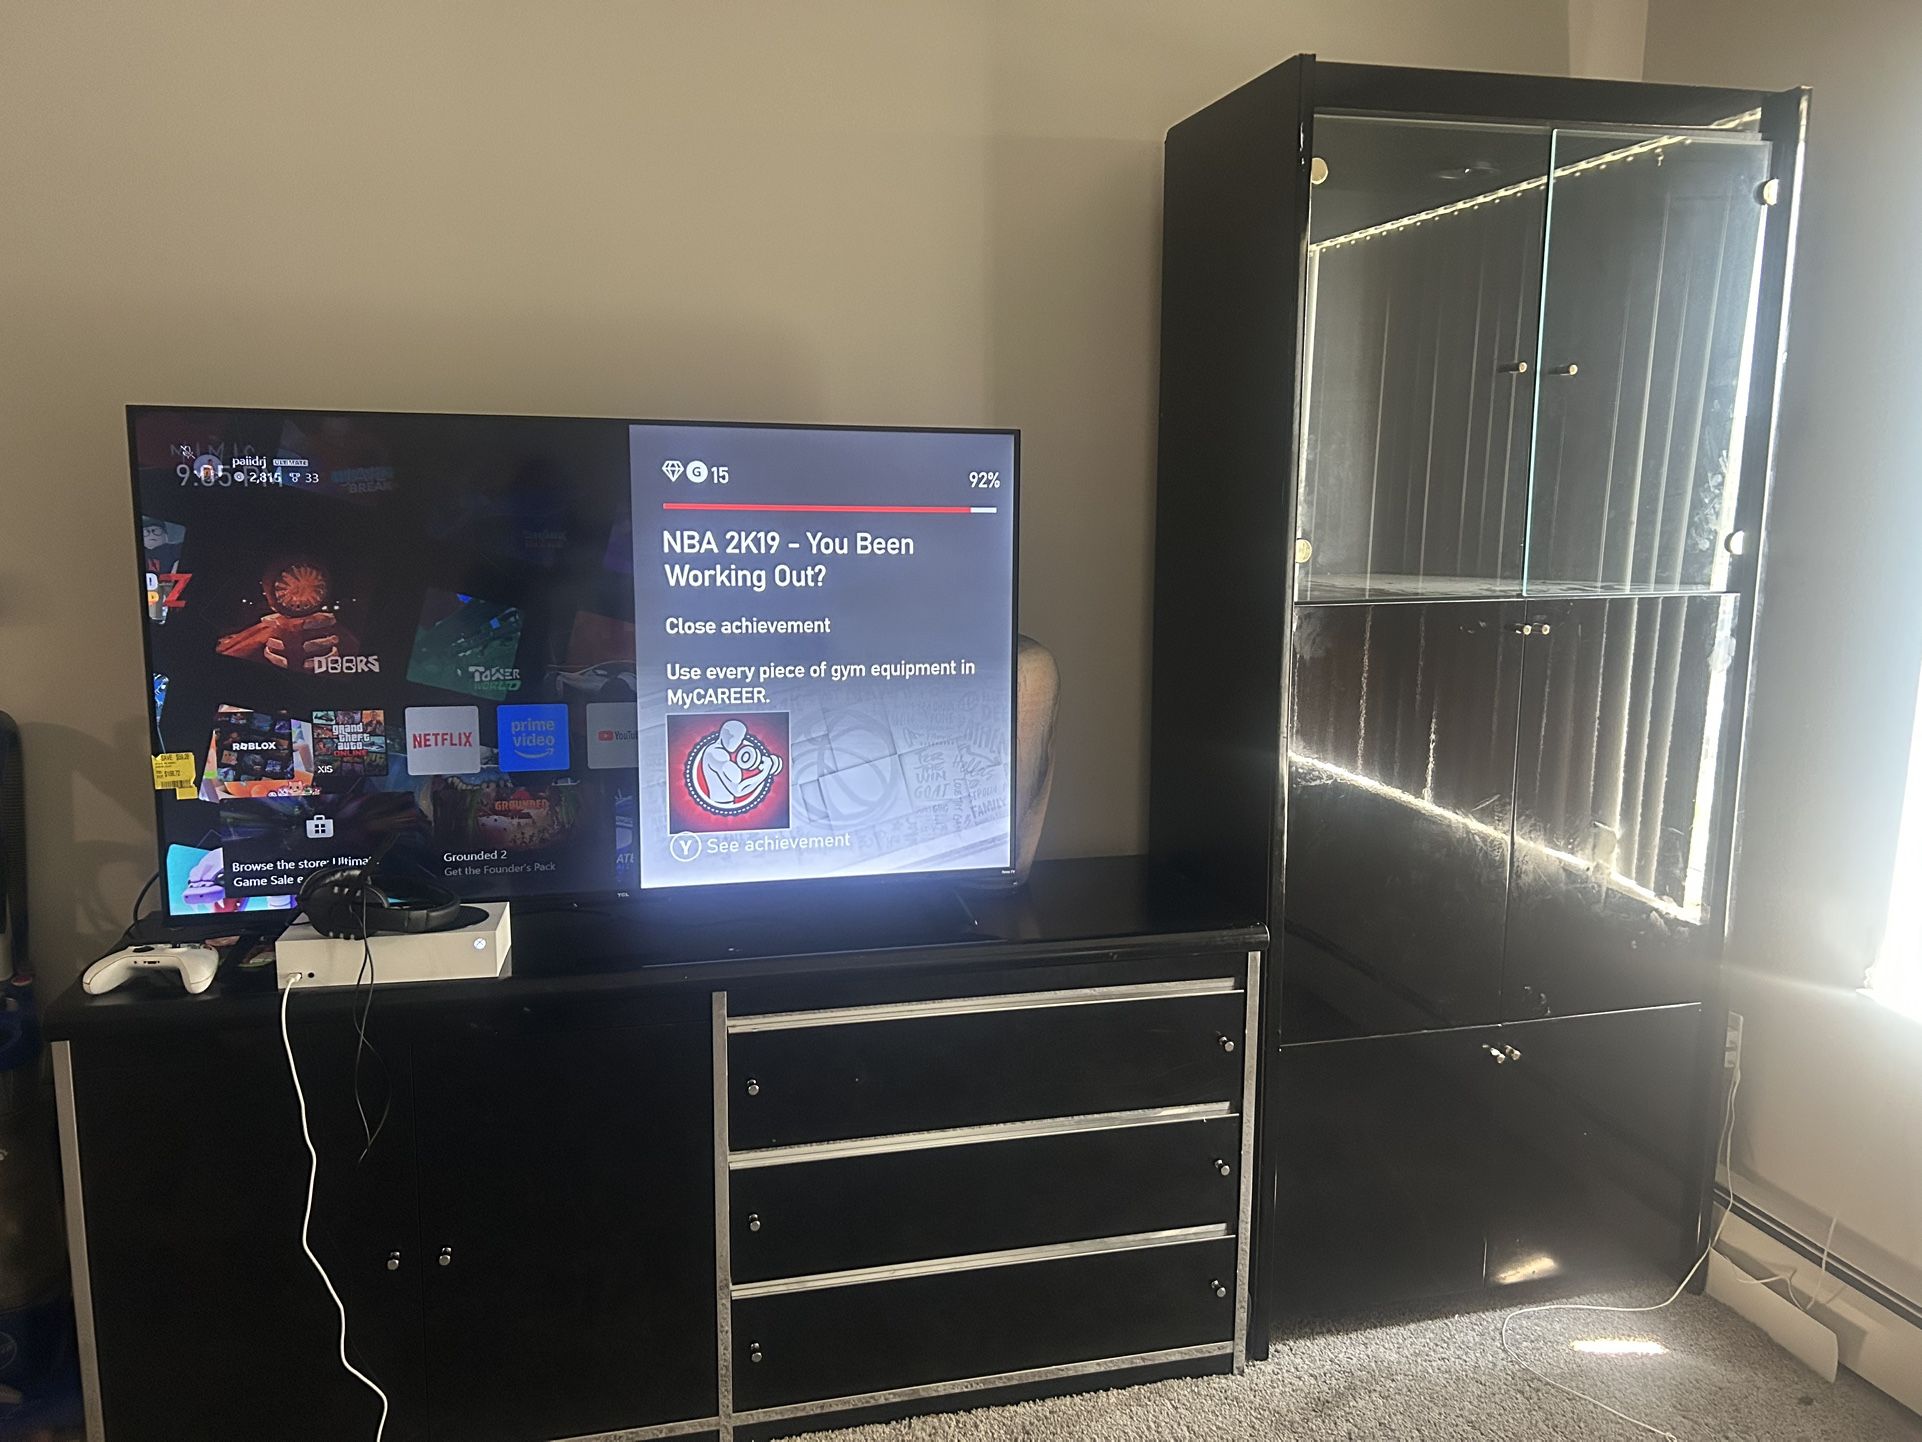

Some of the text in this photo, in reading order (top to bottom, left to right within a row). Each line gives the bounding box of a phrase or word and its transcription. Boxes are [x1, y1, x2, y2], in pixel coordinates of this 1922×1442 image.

[249, 472, 282, 484] 2,815
[305, 473, 319, 483] 33
[711, 467, 729, 483] 15
[969, 472, 1001, 488] 92%
[663, 531, 718, 553] NBA
[725, 531, 780, 554] 2K19
[806, 532, 848, 554] You
[856, 533, 914, 554] Been
[664, 564, 827, 592] Working Out?
[666, 616, 831, 634] Close achievement
[666, 659, 976, 684] Use every piece of gym equipment in
[667, 687, 771, 708] MyCAREER.
[511, 718, 556, 734] prime
[232, 742, 276, 751] ROBLOX
[412, 732, 473, 749] NETFLIX
[513, 733, 556, 747] video
[706, 840, 740, 853] See
[744, 833, 851, 851] achievement
[443, 850, 508, 862] Grounded 2
[232, 862, 274, 872] Browse
[276, 859, 296, 870] the
[444, 862, 556, 876] Get the Founder's Pack
[233, 877, 268, 887] Game
[270, 875, 294, 885] Sale
